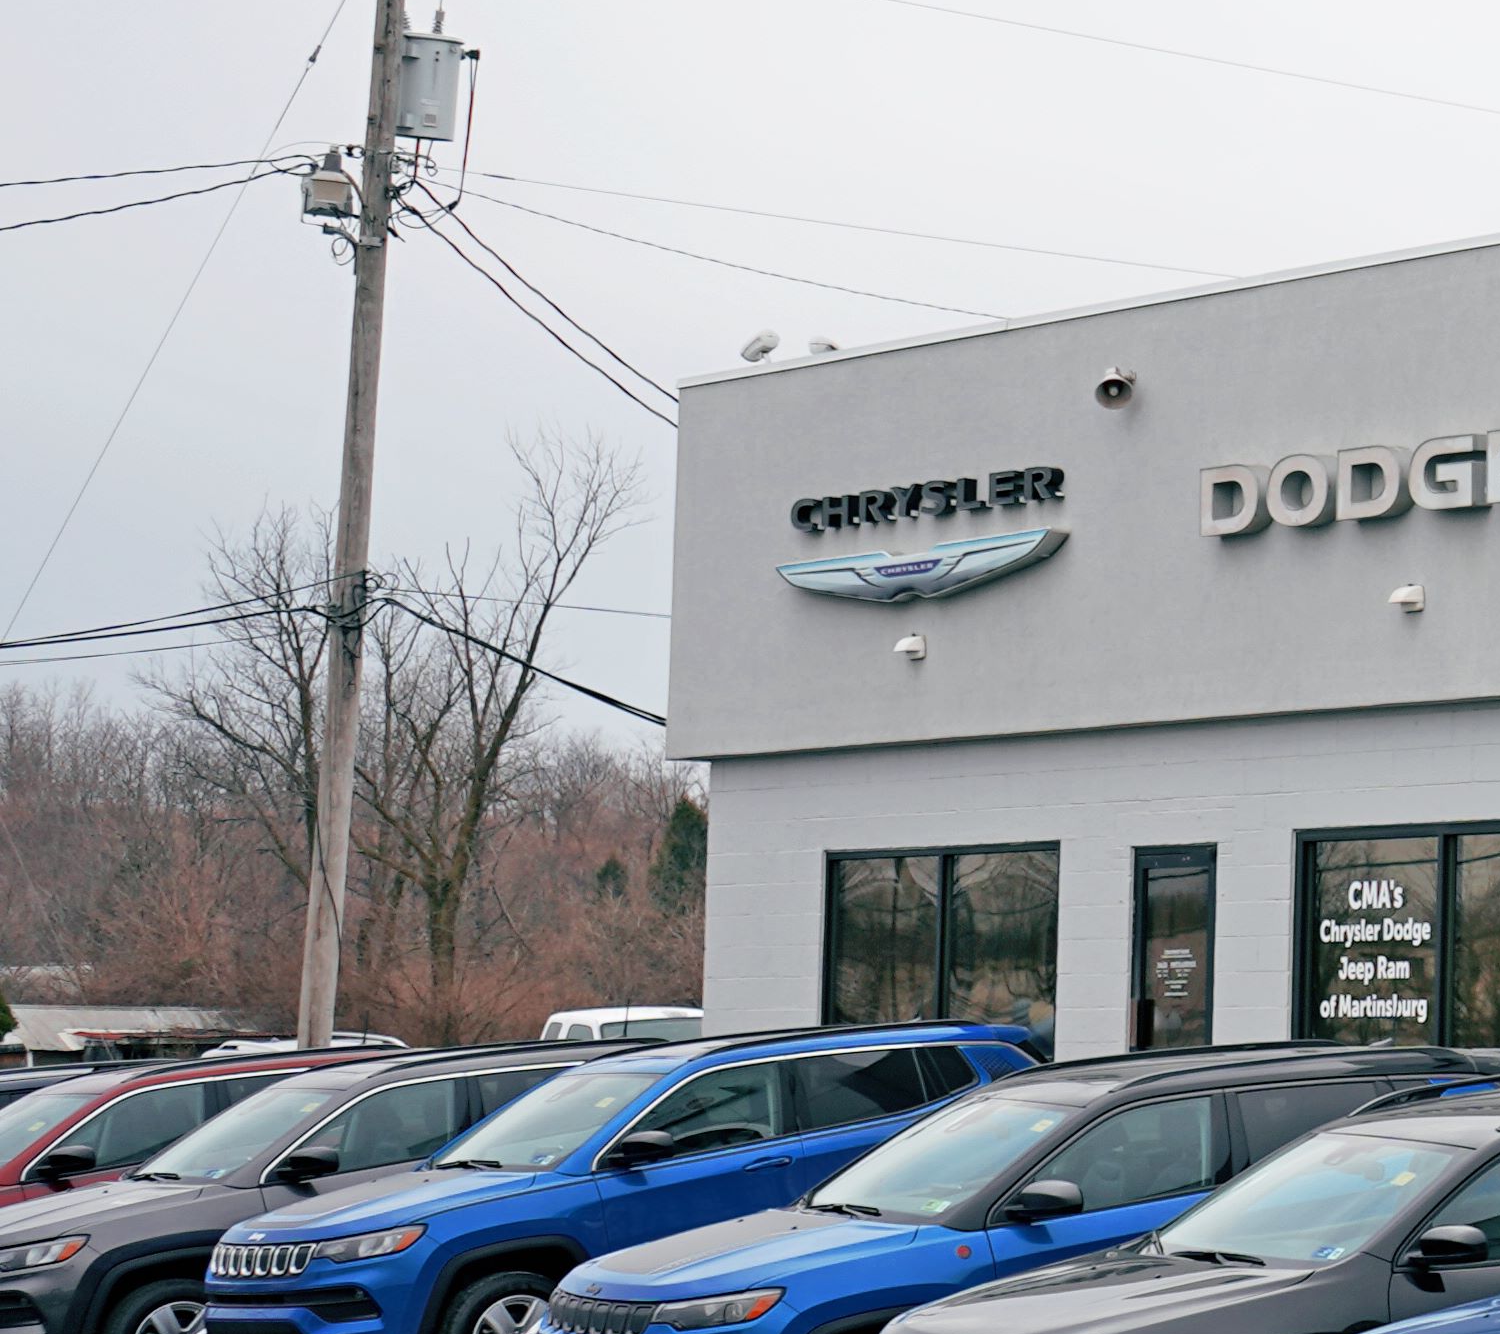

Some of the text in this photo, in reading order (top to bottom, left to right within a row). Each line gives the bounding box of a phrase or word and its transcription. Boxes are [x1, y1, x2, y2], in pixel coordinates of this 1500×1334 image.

[790, 466, 1065, 534] CHRYSLER
[879, 562, 935, 576] CHRYSLER
[1347, 879, 1404, 910] CMA's
[1319, 917, 1432, 948] Chrysler Dodge
[1338, 955, 1410, 985] Jeep Ram
[1319, 993, 1428, 1023] of Martinsburg
